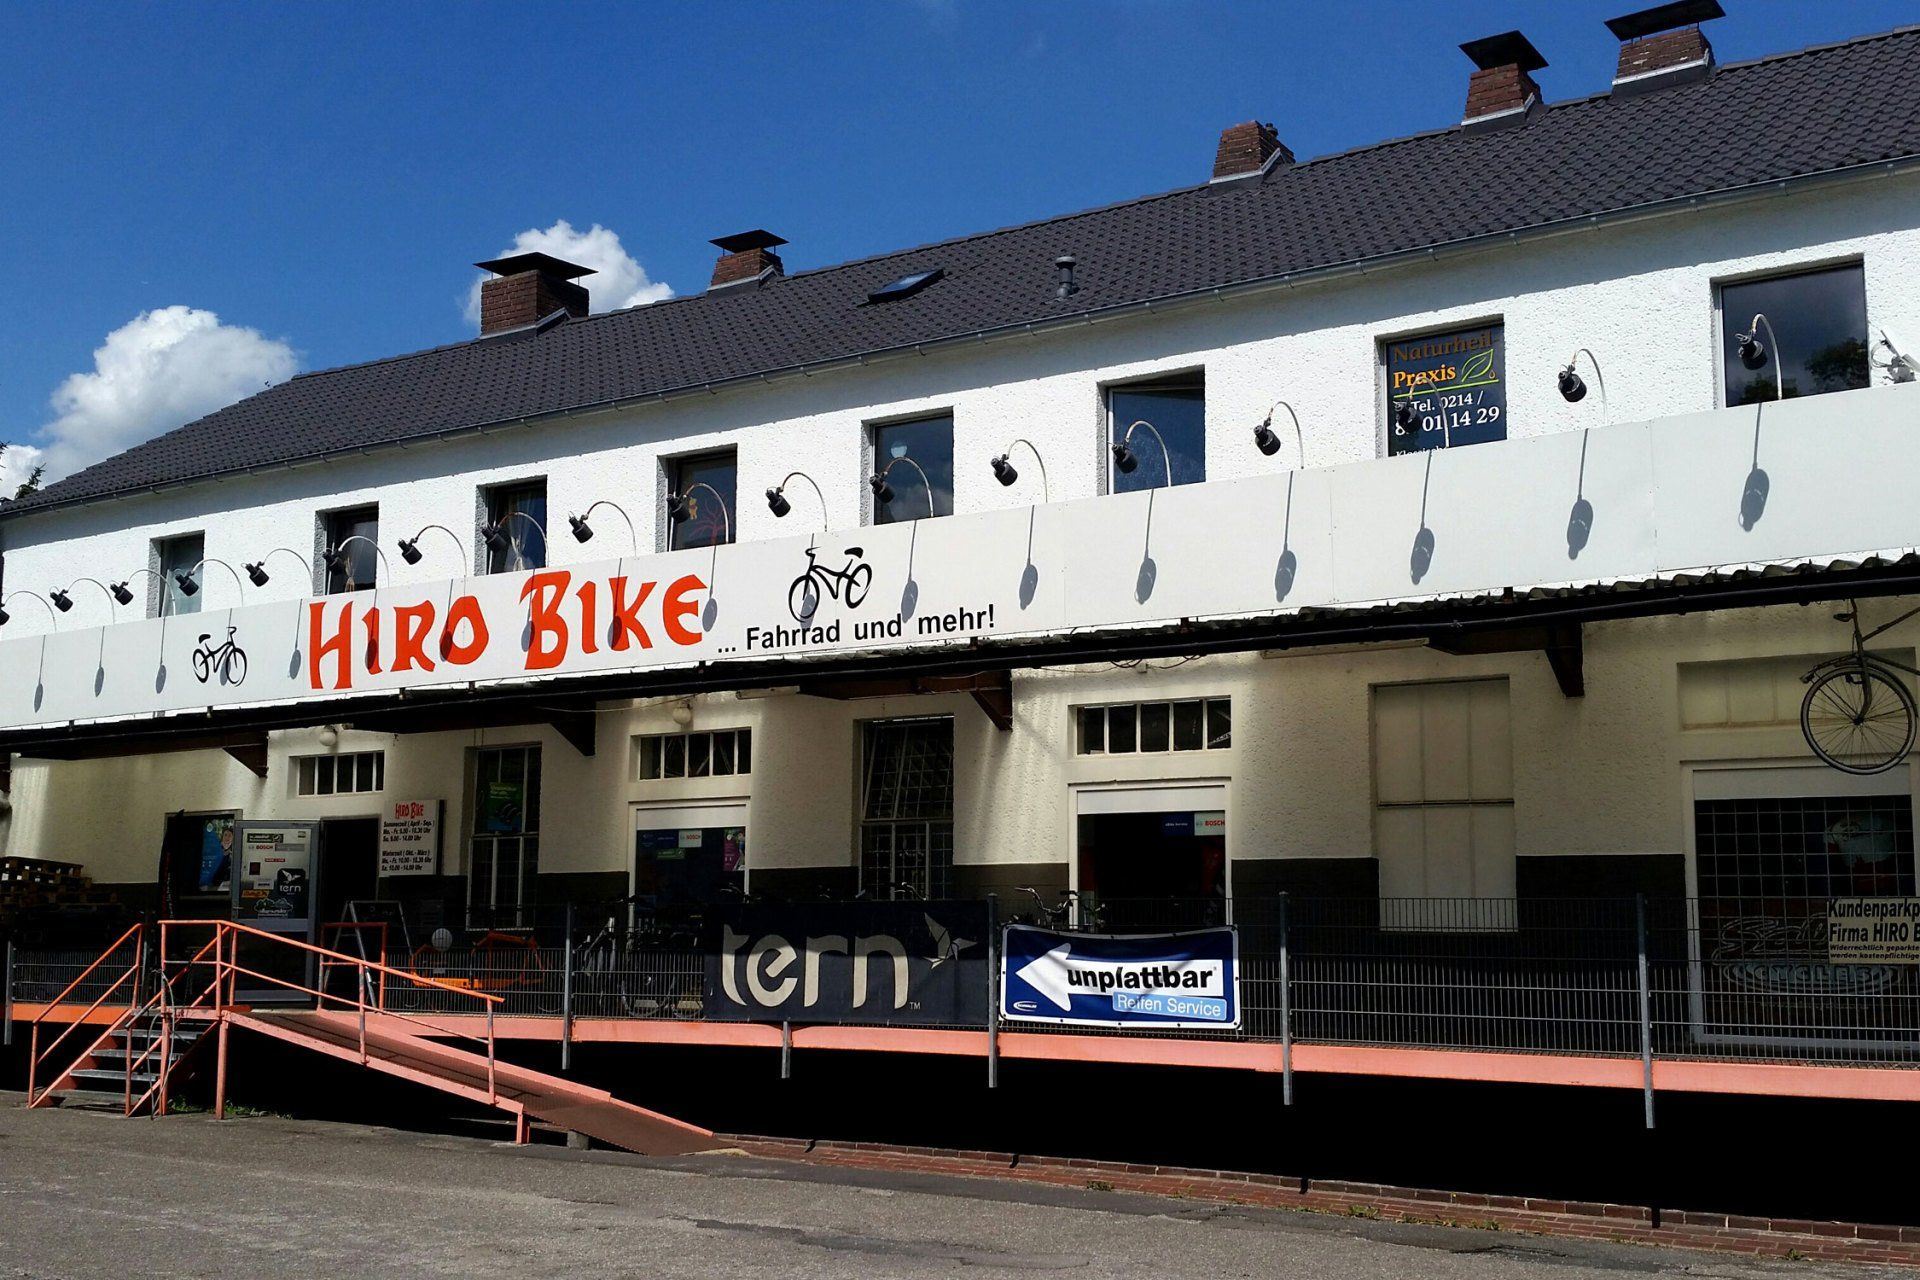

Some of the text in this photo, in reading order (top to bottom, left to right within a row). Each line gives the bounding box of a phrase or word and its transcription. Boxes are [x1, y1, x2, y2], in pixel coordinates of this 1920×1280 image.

[1393, 364, 1456, 388] Praxis
[1410, 399, 1435, 412] Tel.
[1440, 393, 1473, 409] 0214
[1422, 415, 1443, 432] 01
[1451, 410, 1471, 428] 14
[1476, 406, 1500, 424] 29
[309, 570, 707, 690] HIRO BIKE
[746, 619, 840, 650] Fahrrad
[854, 613, 902, 640] und
[918, 603, 995, 635] mehr!
[1830, 923, 1868, 942] Firma
[1873, 922, 1909, 942] HIRO
[722, 923, 909, 1010] tern
[1067, 965, 1213, 992] unplattbar
[1117, 995, 1221, 1016] Reifen Service
